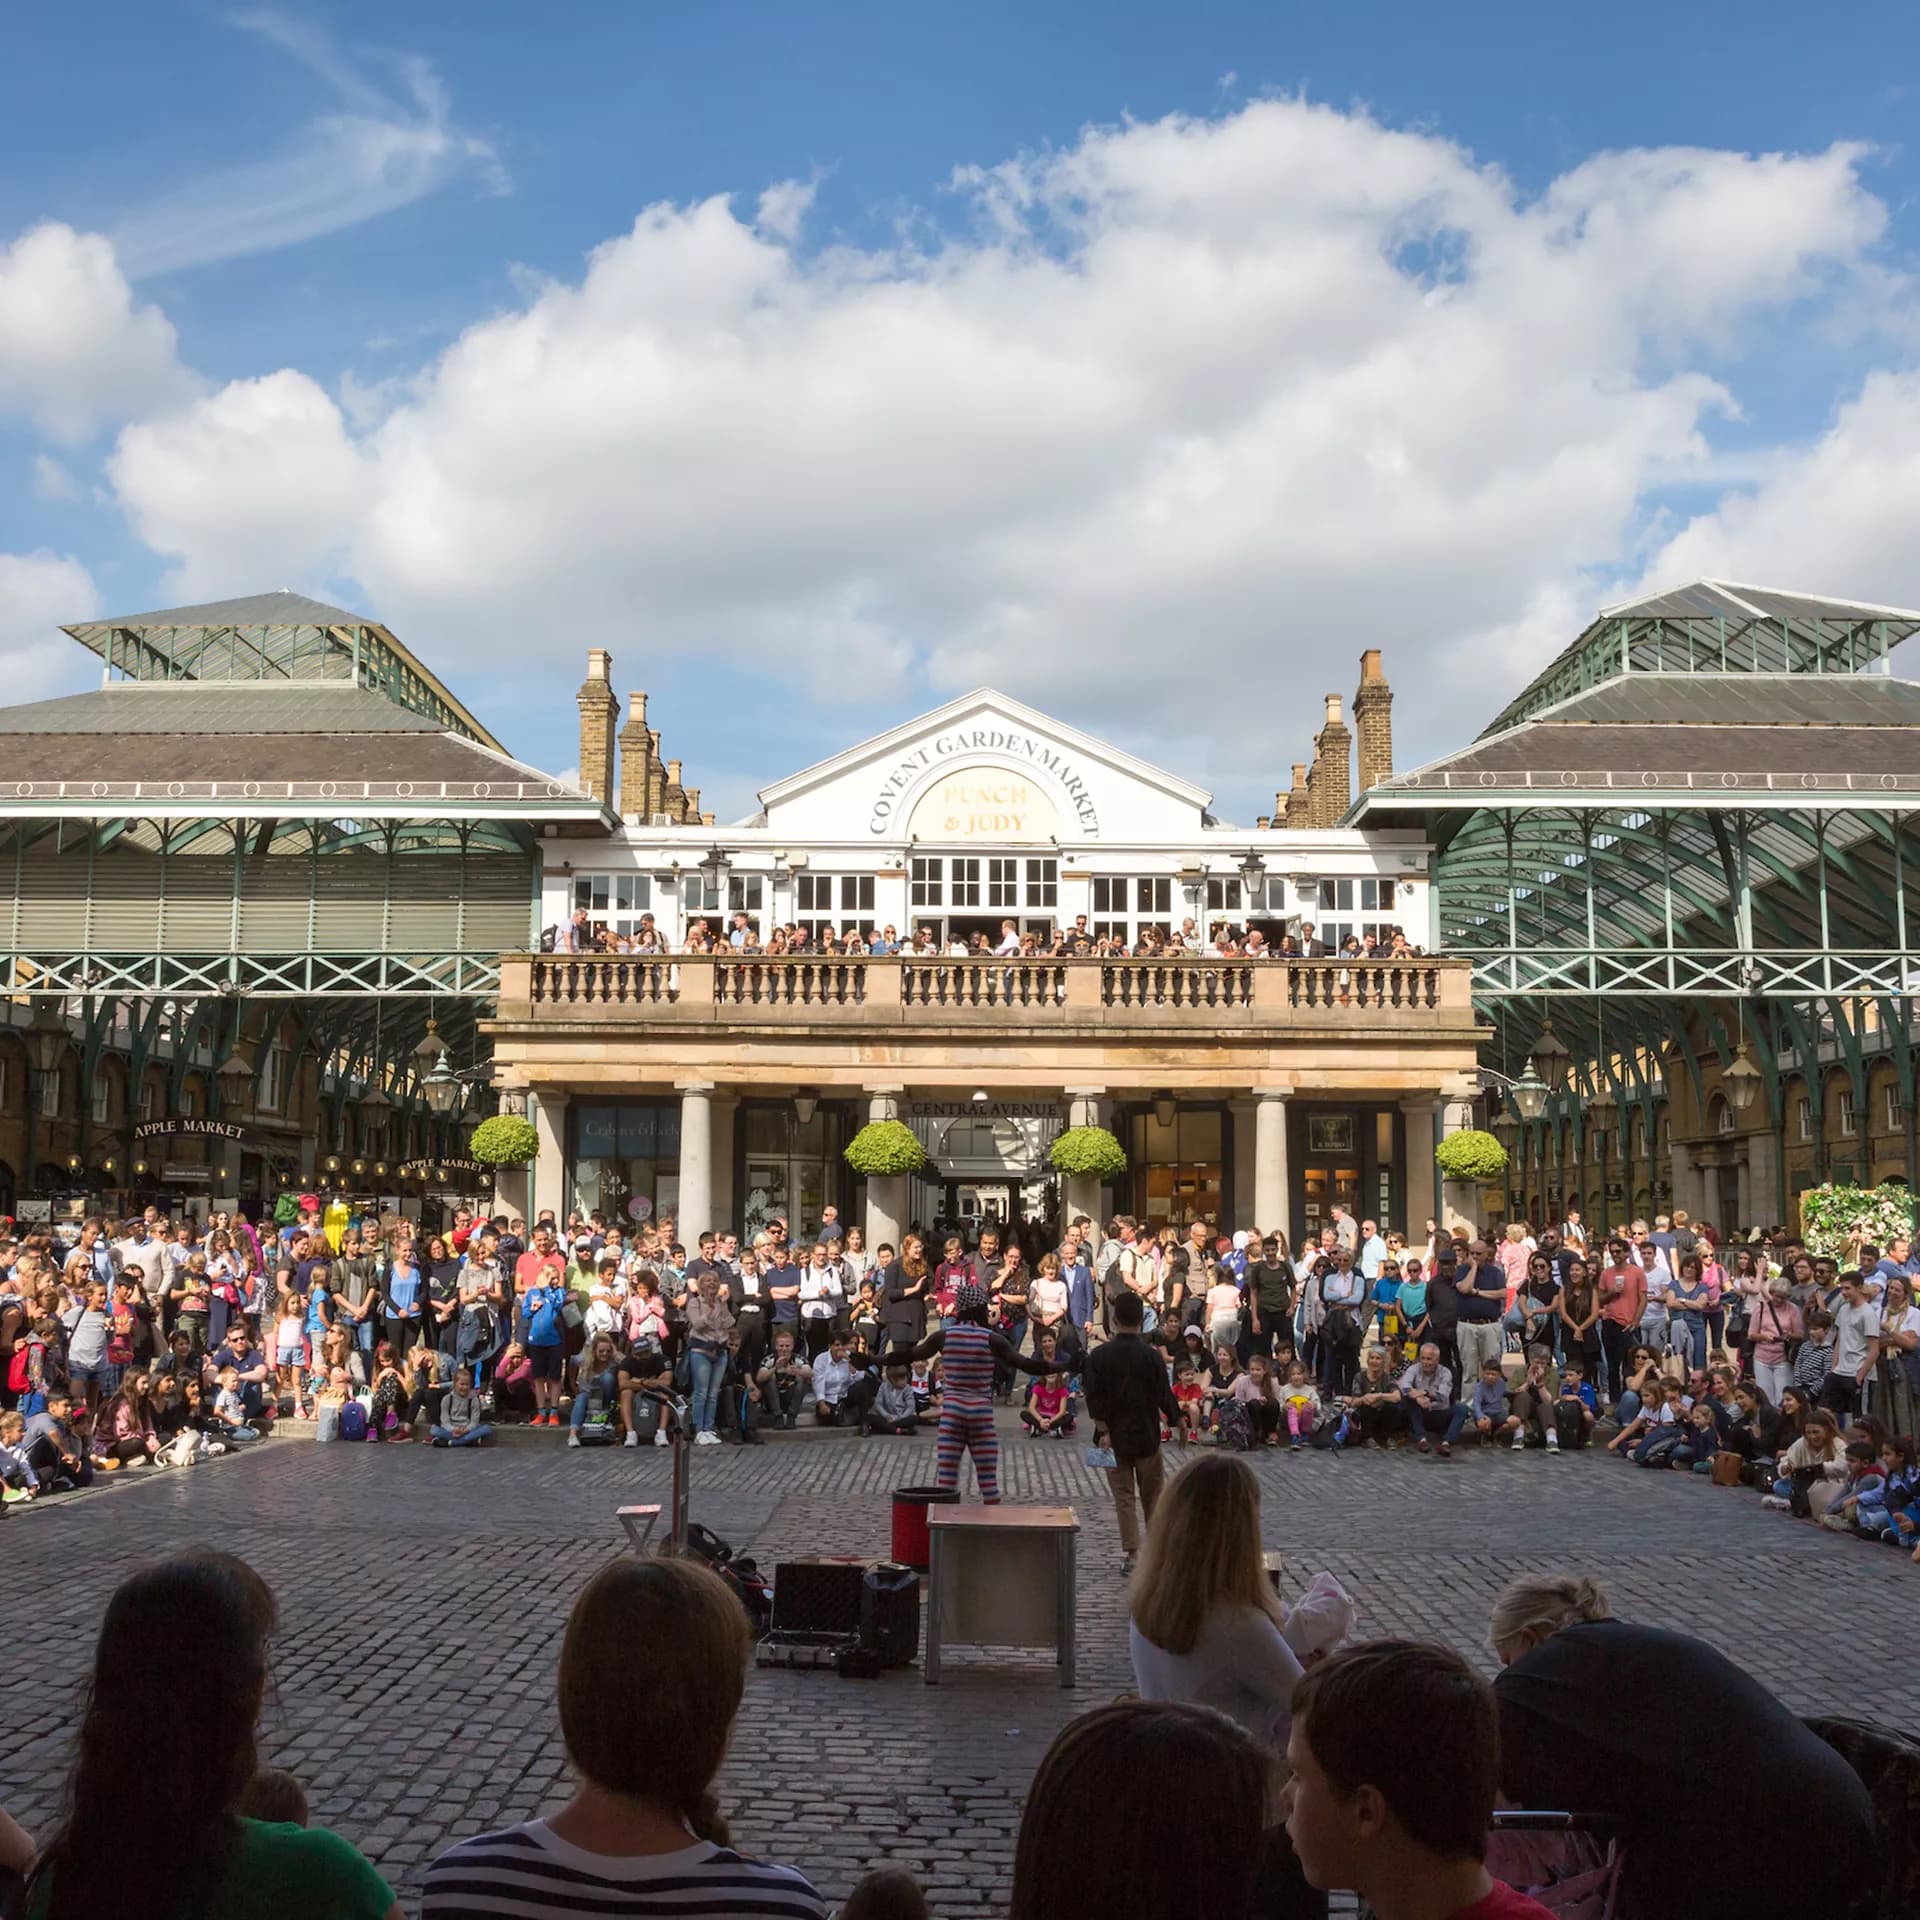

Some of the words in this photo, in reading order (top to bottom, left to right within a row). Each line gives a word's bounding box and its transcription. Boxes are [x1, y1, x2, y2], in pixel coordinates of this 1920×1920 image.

[870, 747, 930, 835] COVENT
[935, 731, 1039, 757] GARDEN
[1038, 748, 1099, 838] MARKET
[944, 786, 1028, 805] PUNCH
[944, 816, 959, 831] &
[965, 815, 1027, 834] JUDY
[912, 1103, 988, 1116] CENTRAL
[990, 1103, 1057, 1116] AVENUE
[134, 1120, 177, 1139] APPLE
[183, 1120, 245, 1139] MARKET
[406, 1159, 435, 1170] APPLE
[440, 1159, 485, 1172] MARKET
